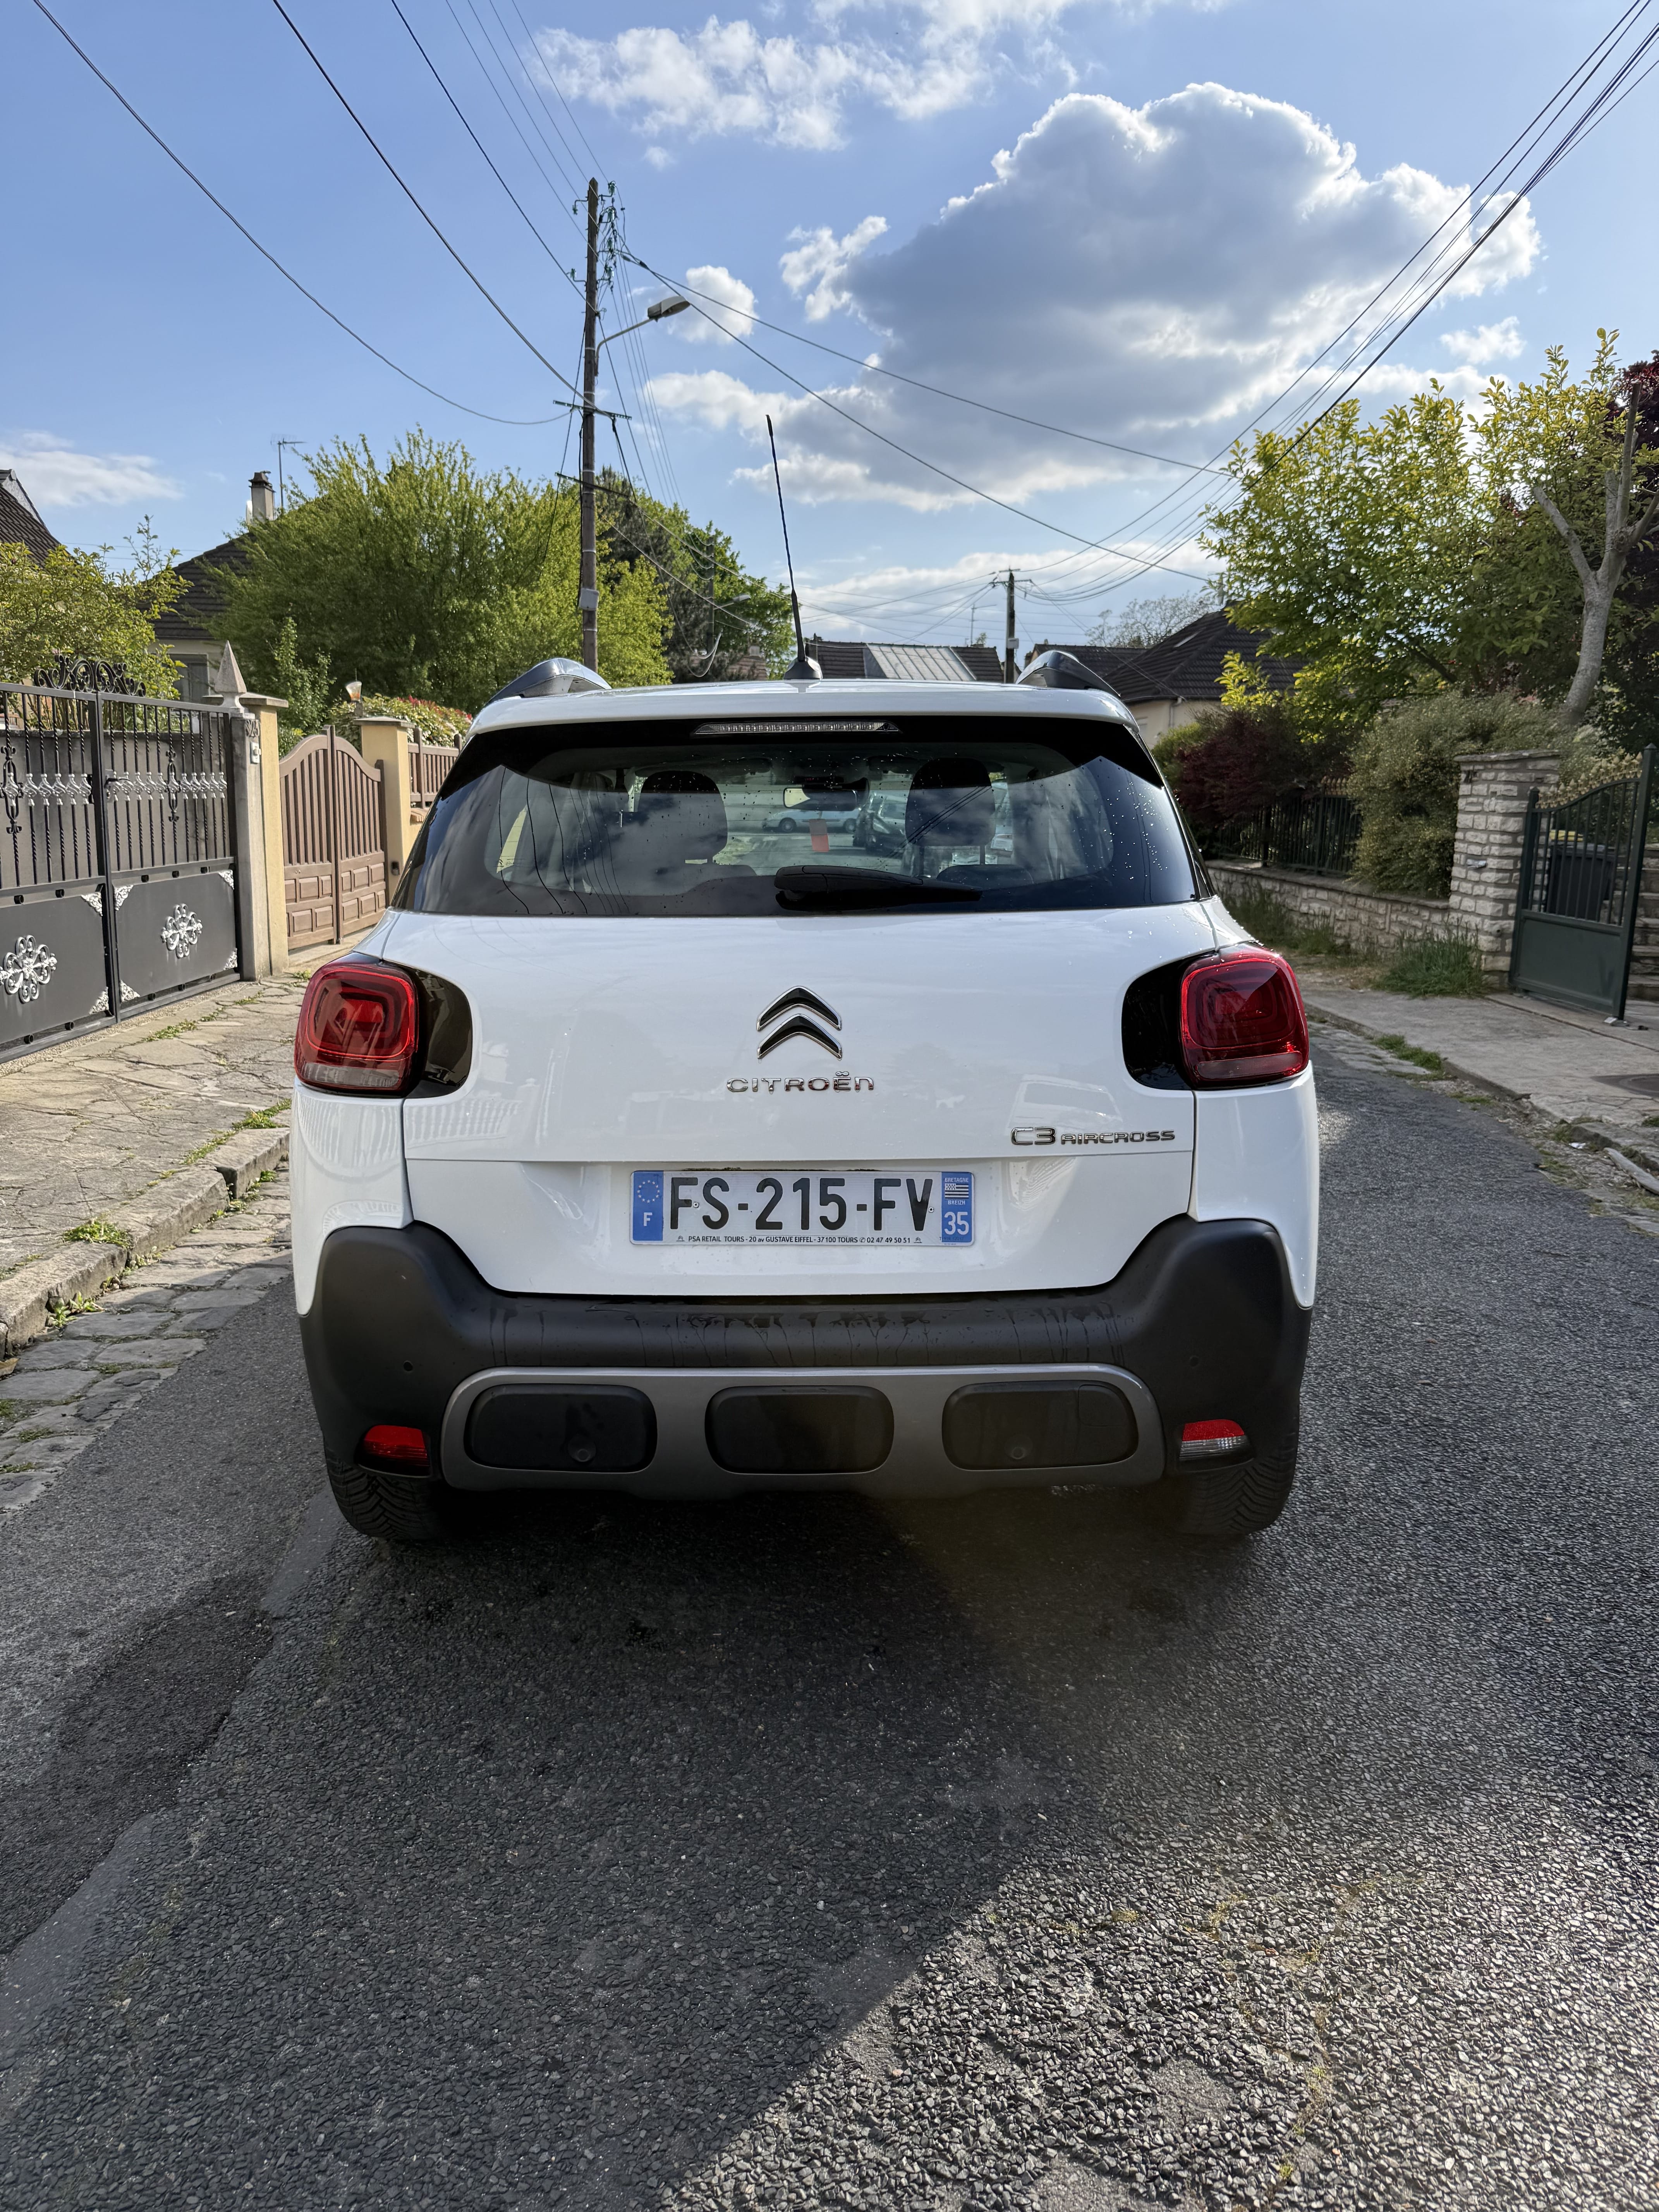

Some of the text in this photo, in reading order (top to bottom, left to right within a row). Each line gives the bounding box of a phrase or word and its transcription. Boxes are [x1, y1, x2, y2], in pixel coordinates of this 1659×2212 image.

[1011, 1127, 1175, 1146] C3 AIRCROSS
[670, 1177, 933, 1231] FS-215-FV
[644, 1212, 653, 1226] F
[944, 1211, 969, 1235] 35
